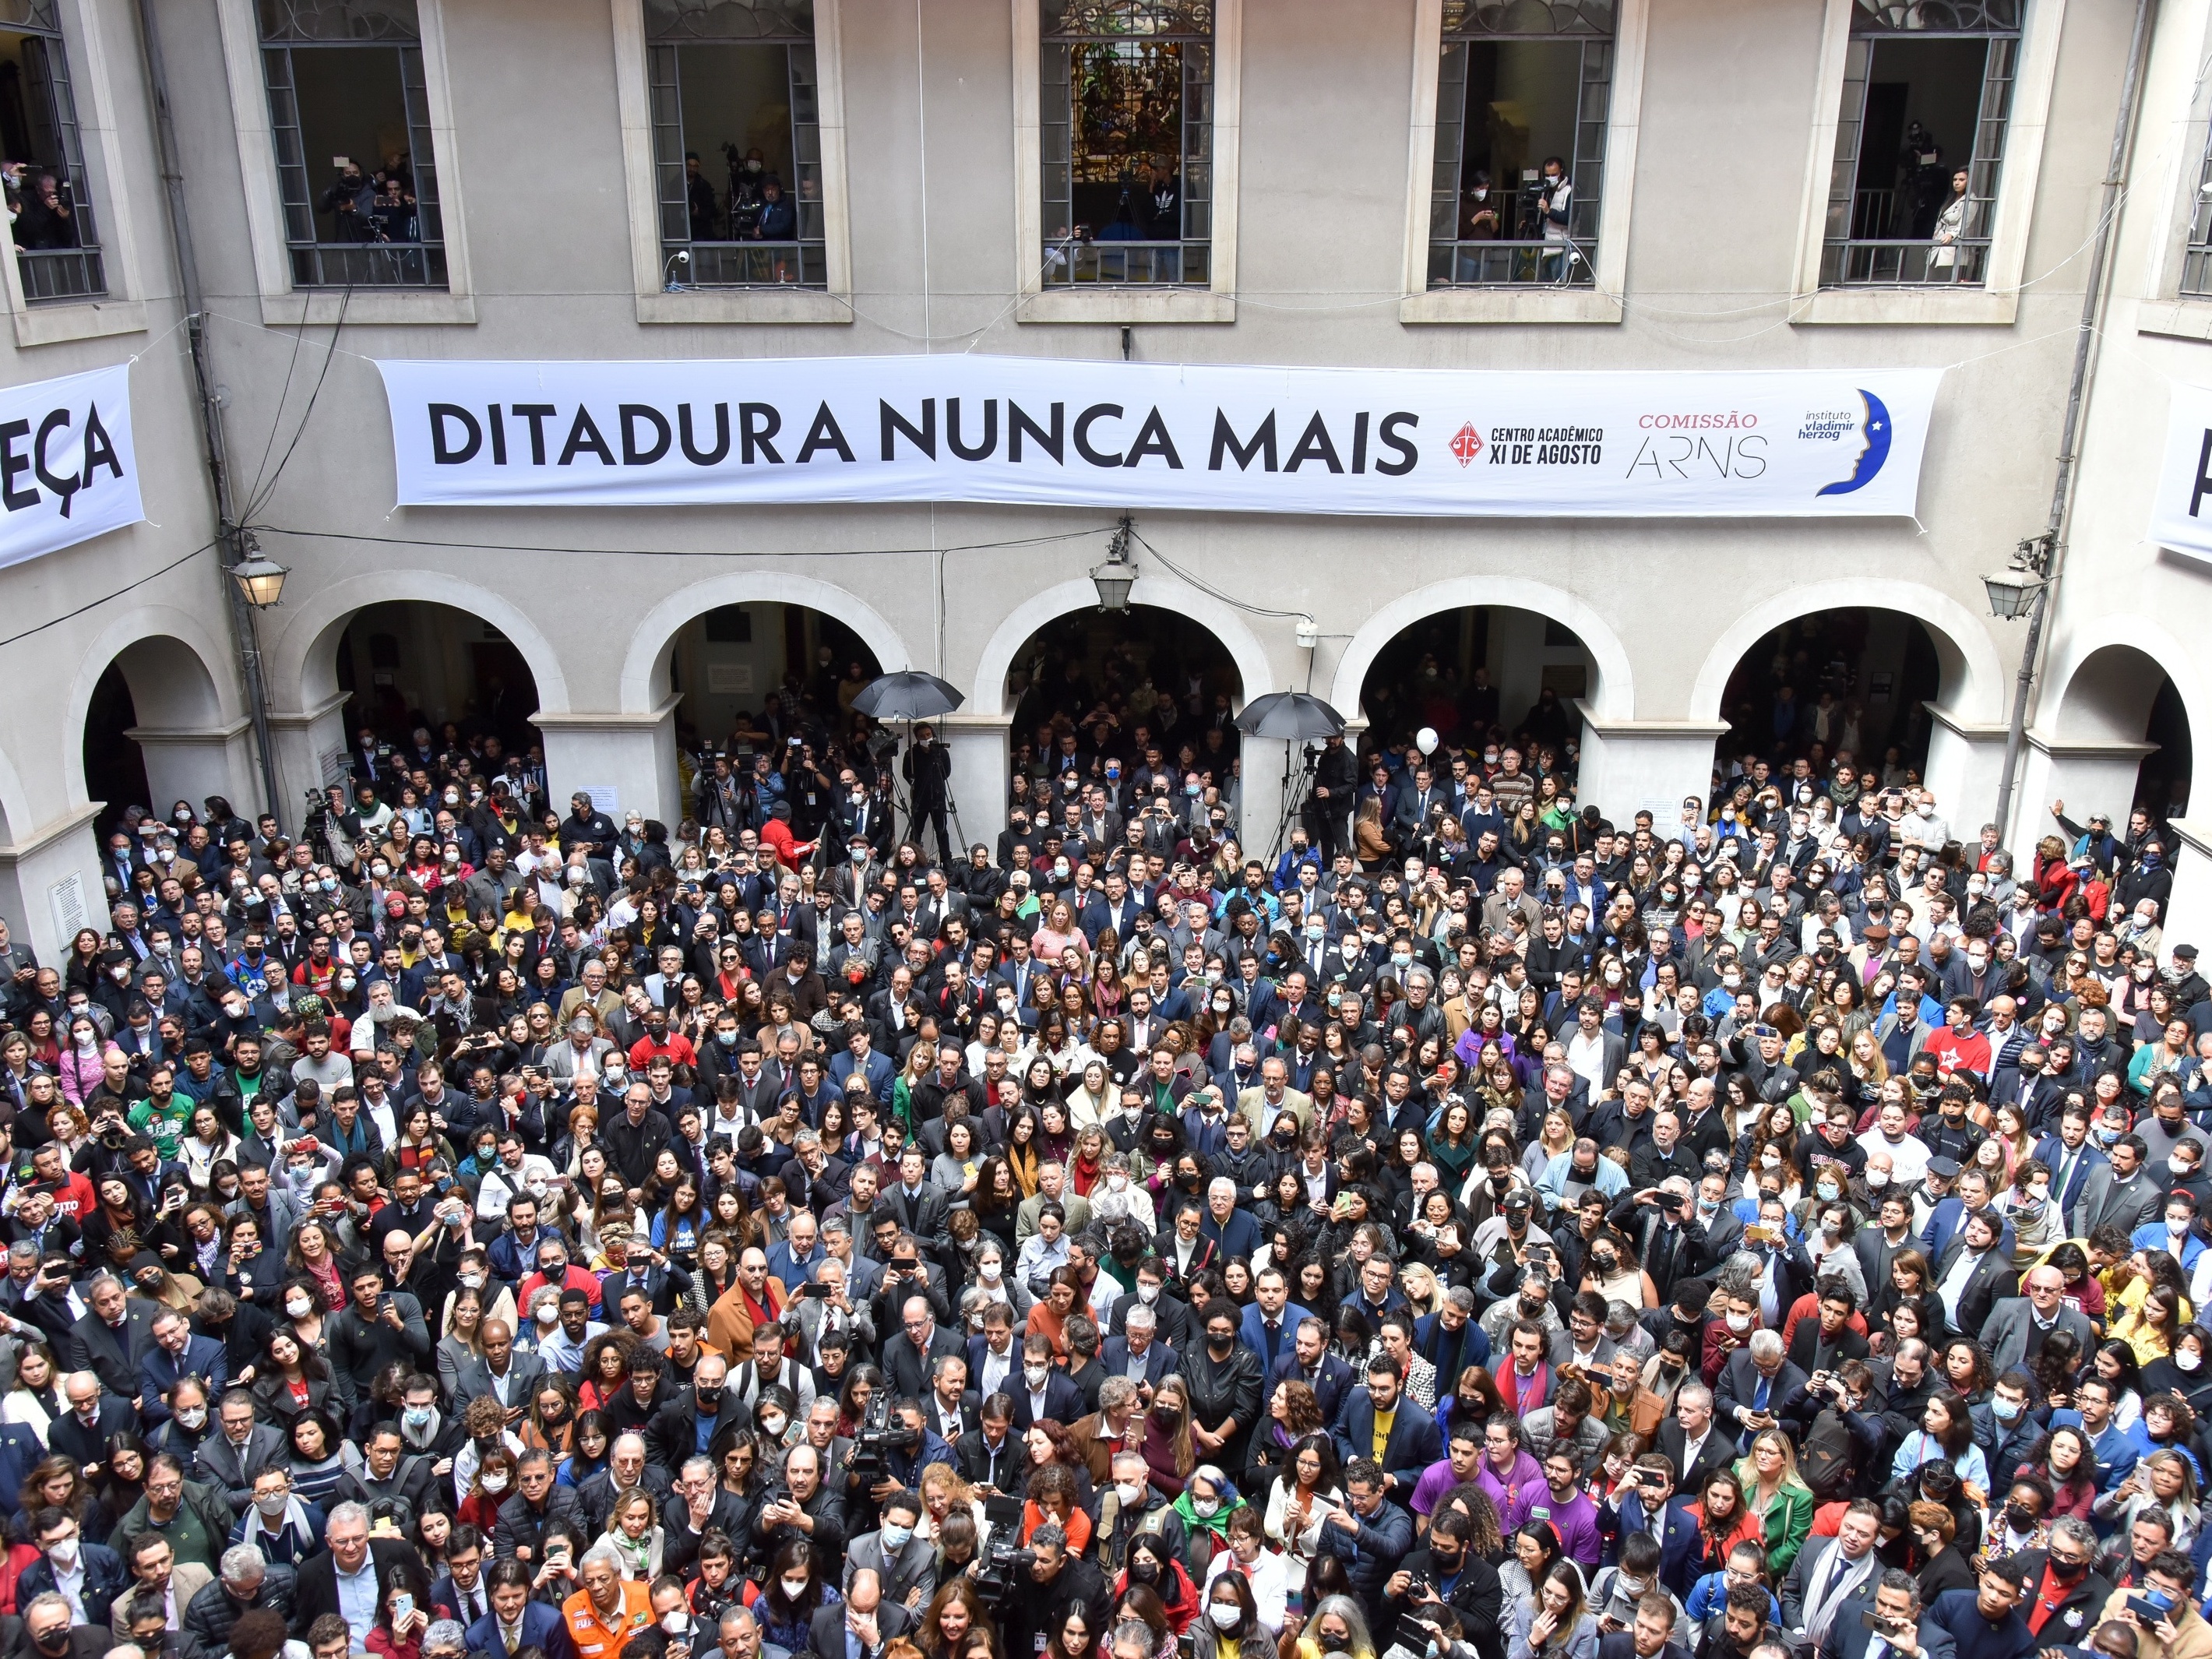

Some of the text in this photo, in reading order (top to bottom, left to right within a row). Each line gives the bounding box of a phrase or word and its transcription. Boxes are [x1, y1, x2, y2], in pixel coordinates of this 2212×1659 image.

[1639, 410, 1757, 428] COMISSÃO
[1805, 410, 1851, 420] instituto
[1491, 426, 1603, 442] CENTRO ACADÊMICO
[1805, 421, 1854, 431] vladimir
[428, 398, 1418, 475] DITADURA NUNCA MAIS
[1798, 429, 1840, 442] herzog
[1489, 445, 1601, 464] XI DE AGOSTO
[1626, 435, 1767, 479] ARNS
[1944, 1054, 1957, 1065] PT
